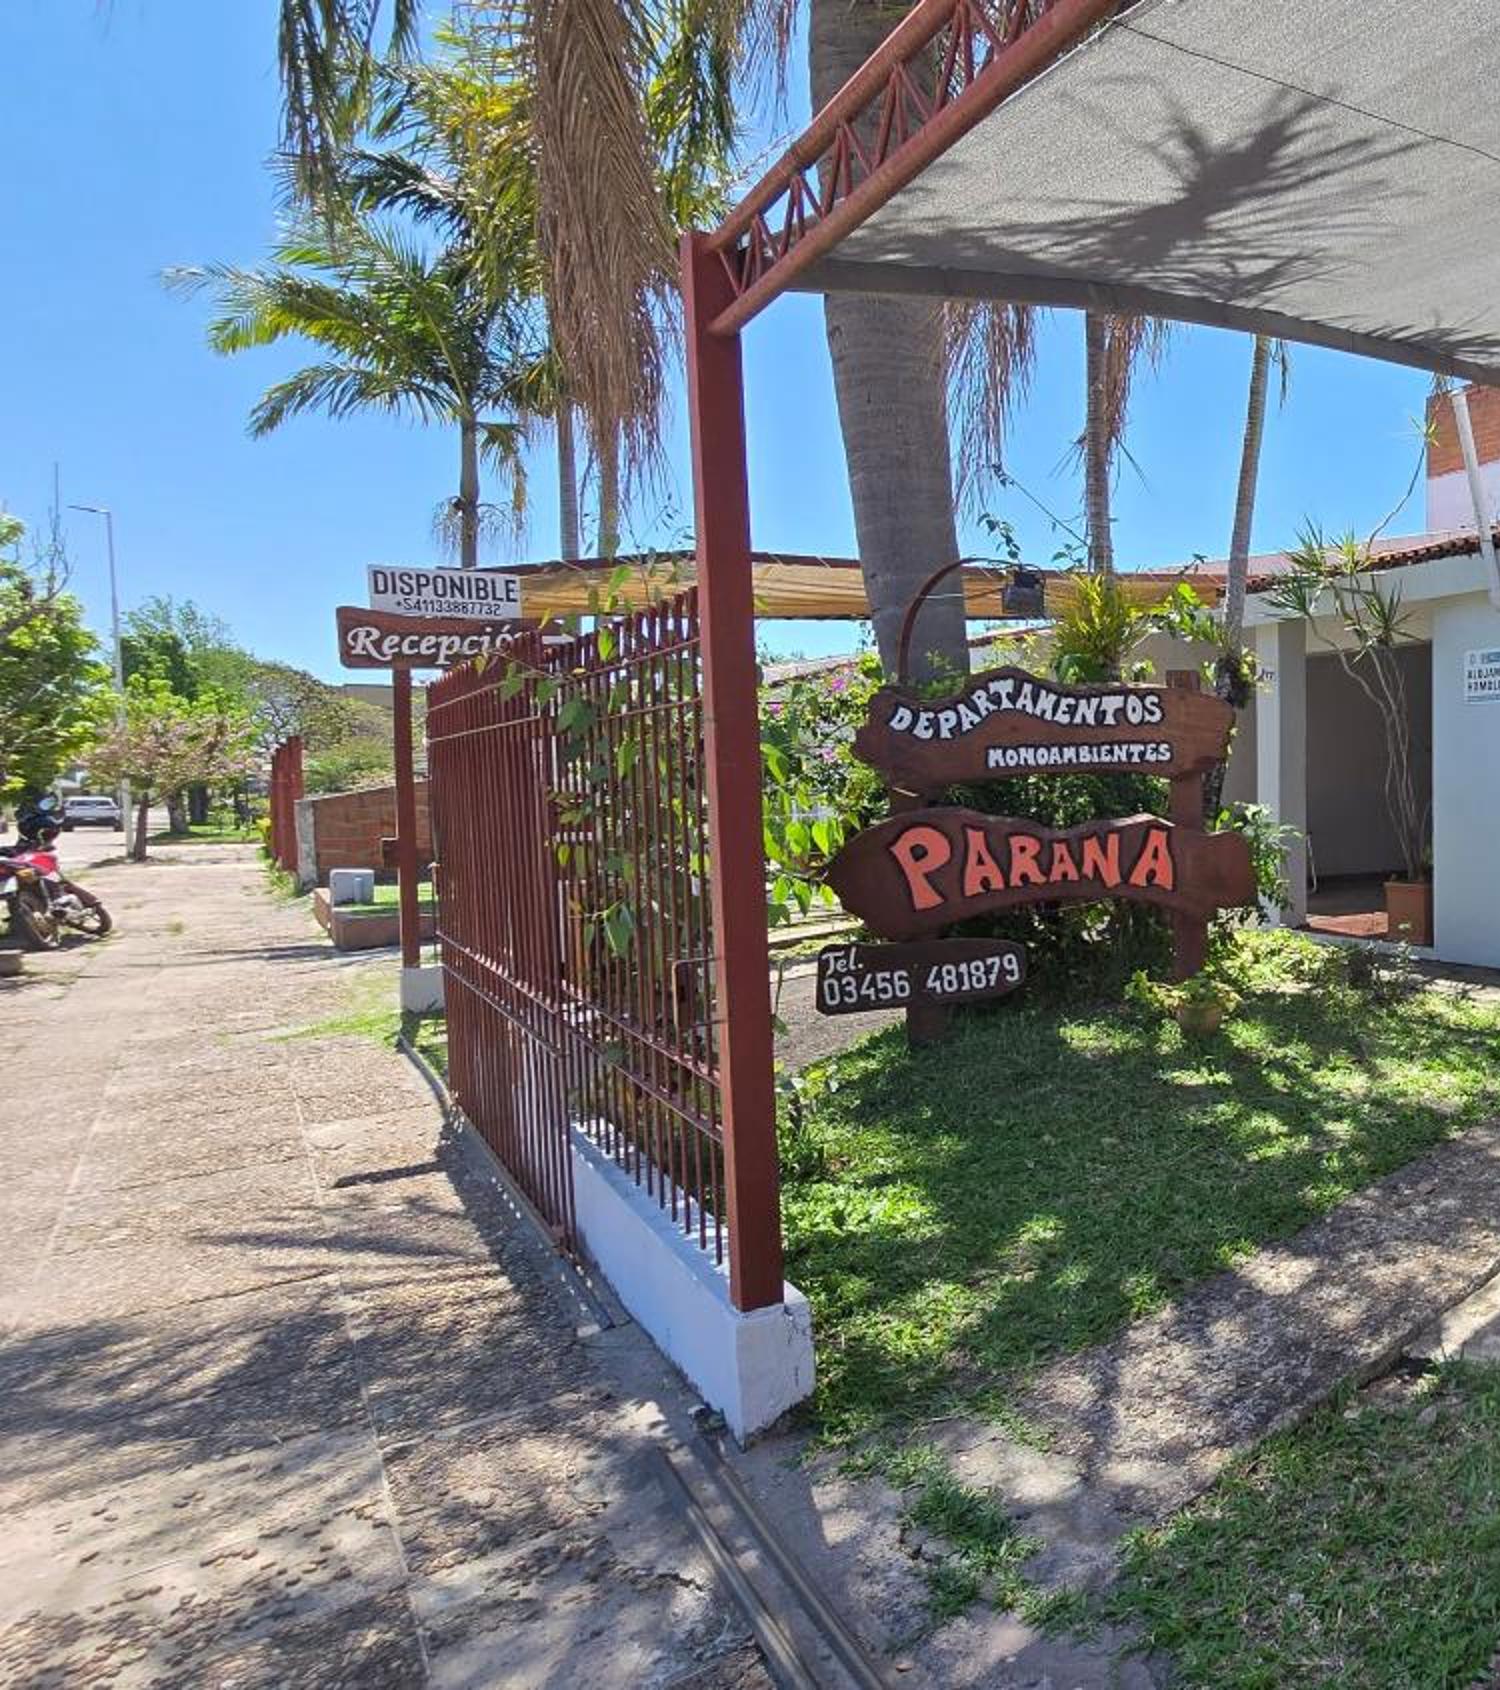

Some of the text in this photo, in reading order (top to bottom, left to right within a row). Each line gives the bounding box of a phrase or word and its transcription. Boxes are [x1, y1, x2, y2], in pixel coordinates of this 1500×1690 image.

[373, 570, 518, 602] DISPONIBLE
[347, 624, 523, 665] Recepció
[889, 678, 1163, 739] DEPARTAMENTOS
[987, 743, 1171, 768] MONOAMBIENTES
[890, 826, 1175, 911] PARANA
[821, 946, 864, 975] Tel.
[823, 953, 1020, 1005] 03456 481879
